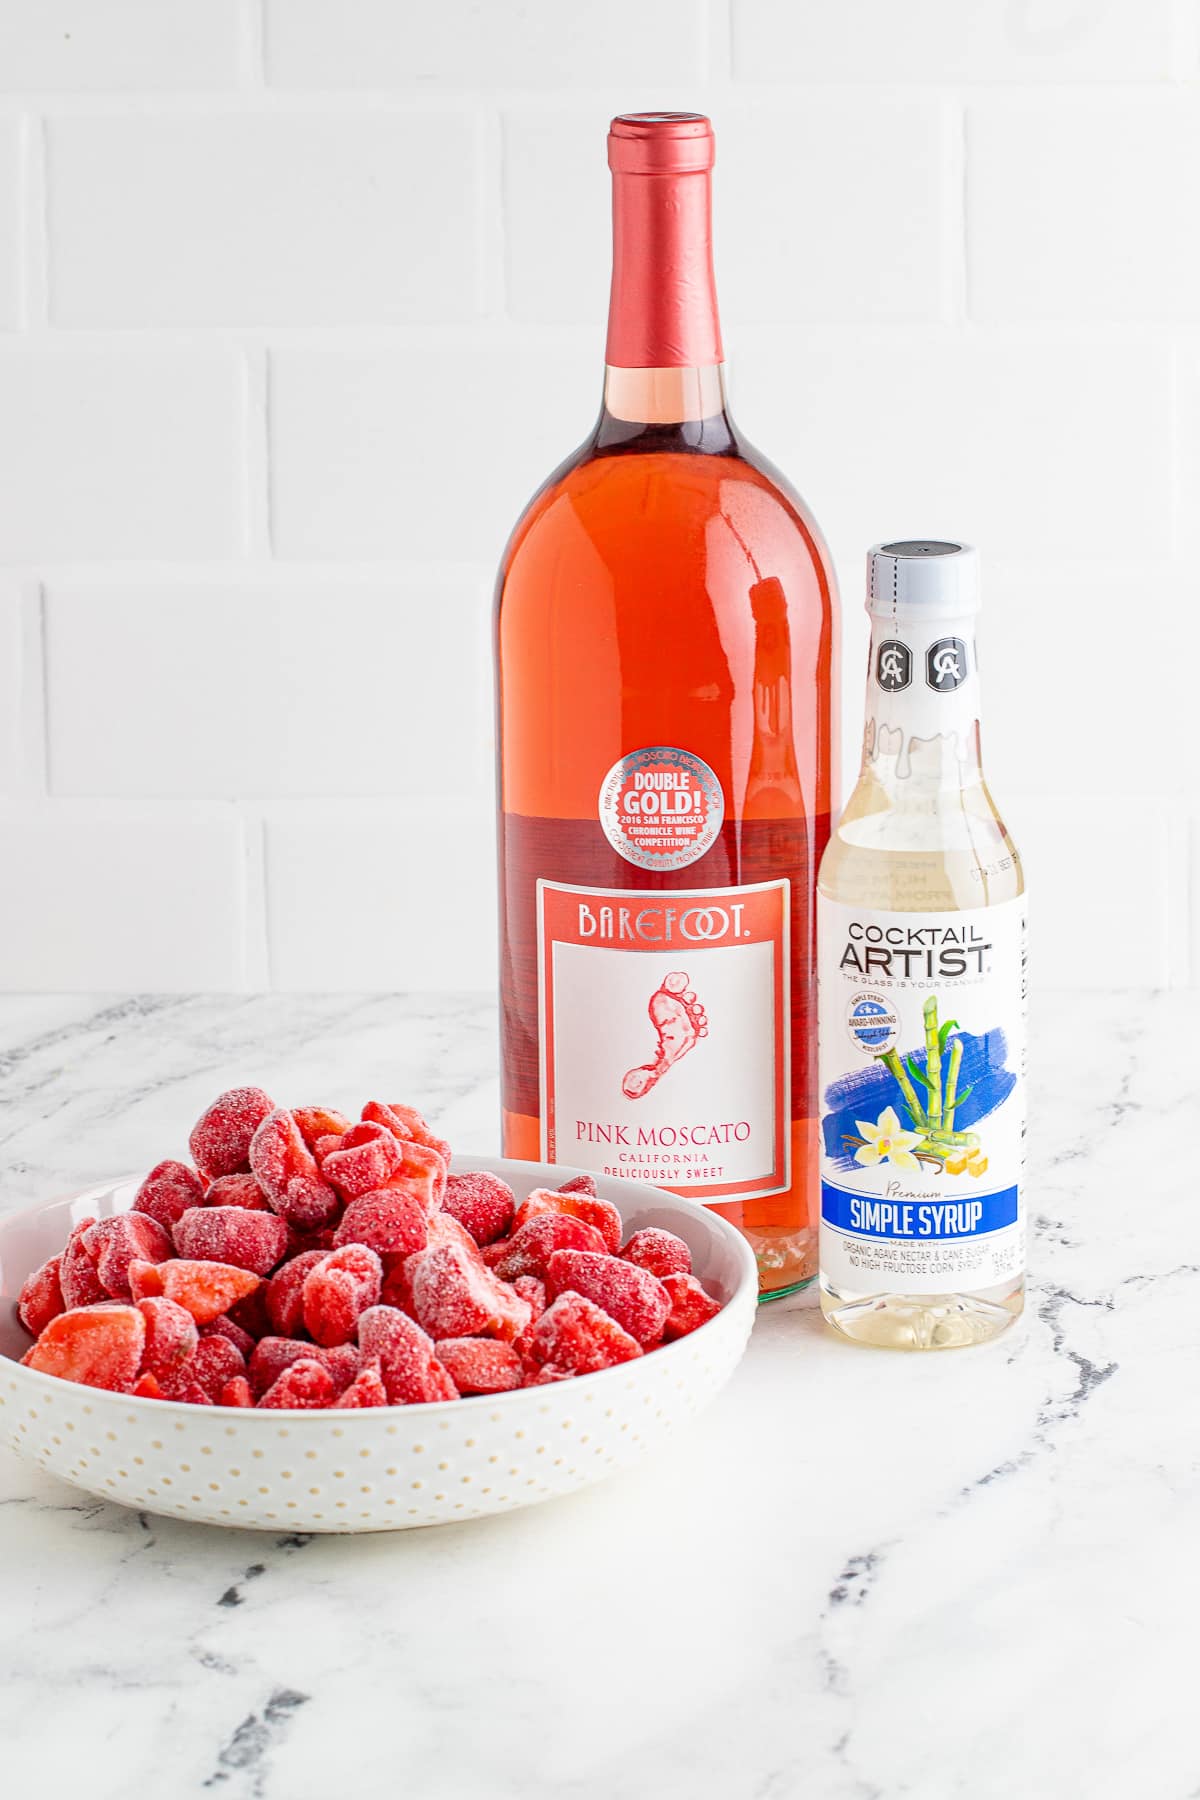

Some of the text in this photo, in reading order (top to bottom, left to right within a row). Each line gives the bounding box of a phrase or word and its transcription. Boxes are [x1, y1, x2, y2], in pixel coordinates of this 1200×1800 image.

[634, 772, 690, 790] DOUBLE
[623, 791, 702, 815] GOLD!
[620, 815, 705, 825] 2016 SAN FRANCISCO
[628, 826, 697, 836] CHRONICLE WINE
[634, 837, 691, 847] COMPETITION
[848, 922, 983, 945] COCKTAIL
[843, 973, 858, 983] THE
[861, 977, 893, 987] GLASS
[910, 981, 941, 989] YOUR
[576, 1121, 751, 1147] PINK MOSCATO
[618, 1153, 709, 1163] CALIFORNIA
[604, 1166, 724, 1179] DELICIOUSLY SWEET
[886, 1180, 943, 1199] Premium
[850, 1199, 915, 1236] SIMPLE
[918, 1201, 983, 1235] SYRUP
[842, 1241, 872, 1258] ORGANIC
[874, 1249, 899, 1261] AGAVE
[900, 1250, 931, 1262] NECTAR
[934, 1250, 940, 1261] &
[943, 1249, 964, 1261] CANE
[890, 1240, 938, 1248] MADE WITH
[849, 1256, 860, 1269] NO
[862, 1259, 881, 1271] HIGH
[883, 1261, 928, 1274] FRUCTOSE
[930, 1261, 954, 1274] CORN
